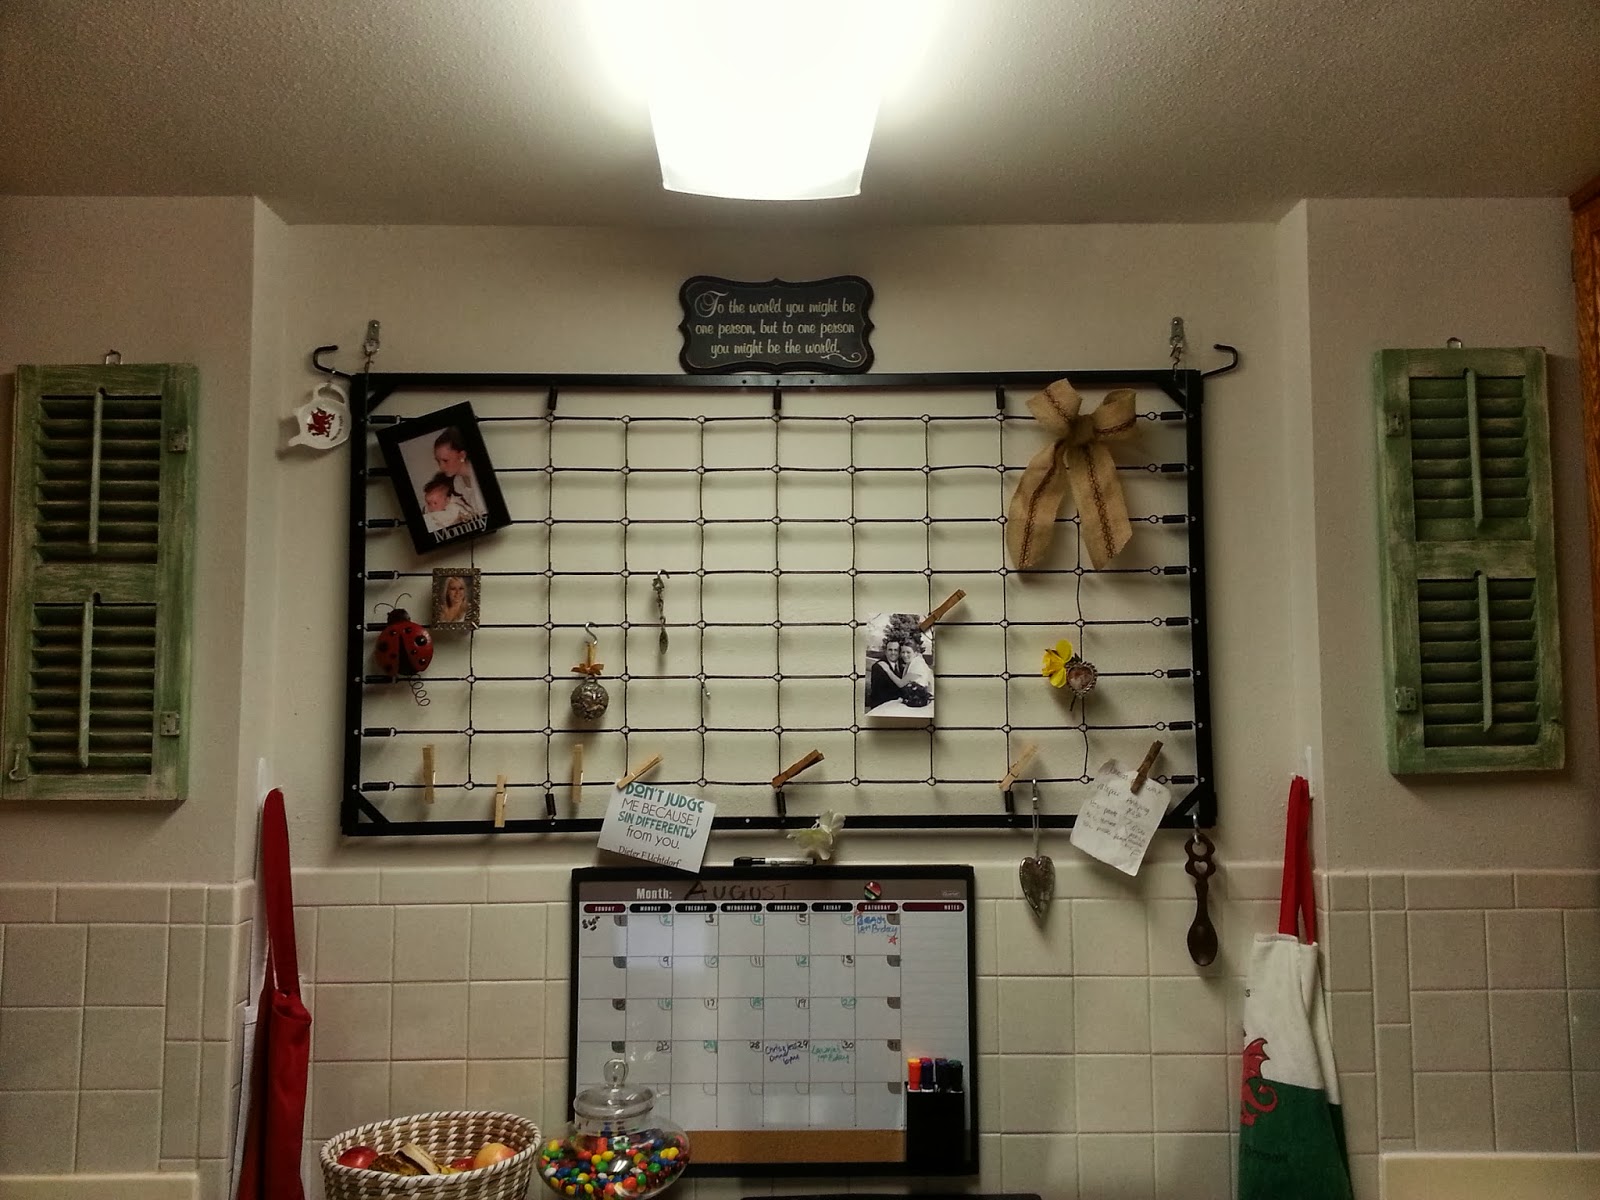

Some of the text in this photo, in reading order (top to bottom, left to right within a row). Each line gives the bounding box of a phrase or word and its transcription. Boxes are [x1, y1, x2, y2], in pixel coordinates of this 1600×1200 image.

[694, 290, 856, 318] To the world you might be
[695, 319, 855, 339] one person, but to one person
[710, 338, 841, 359] you might be the world.
[433, 515, 489, 544] Mommy
[625, 783, 705, 813] DON'T JUDGE
[621, 798, 640, 813] ME
[641, 802, 694, 826] BECAUSE
[617, 811, 697, 840] SIN DIFFERENTLY
[626, 825, 652, 842] from
[636, 888, 673, 900] Month:
[684, 880, 790, 900] AUGUST
